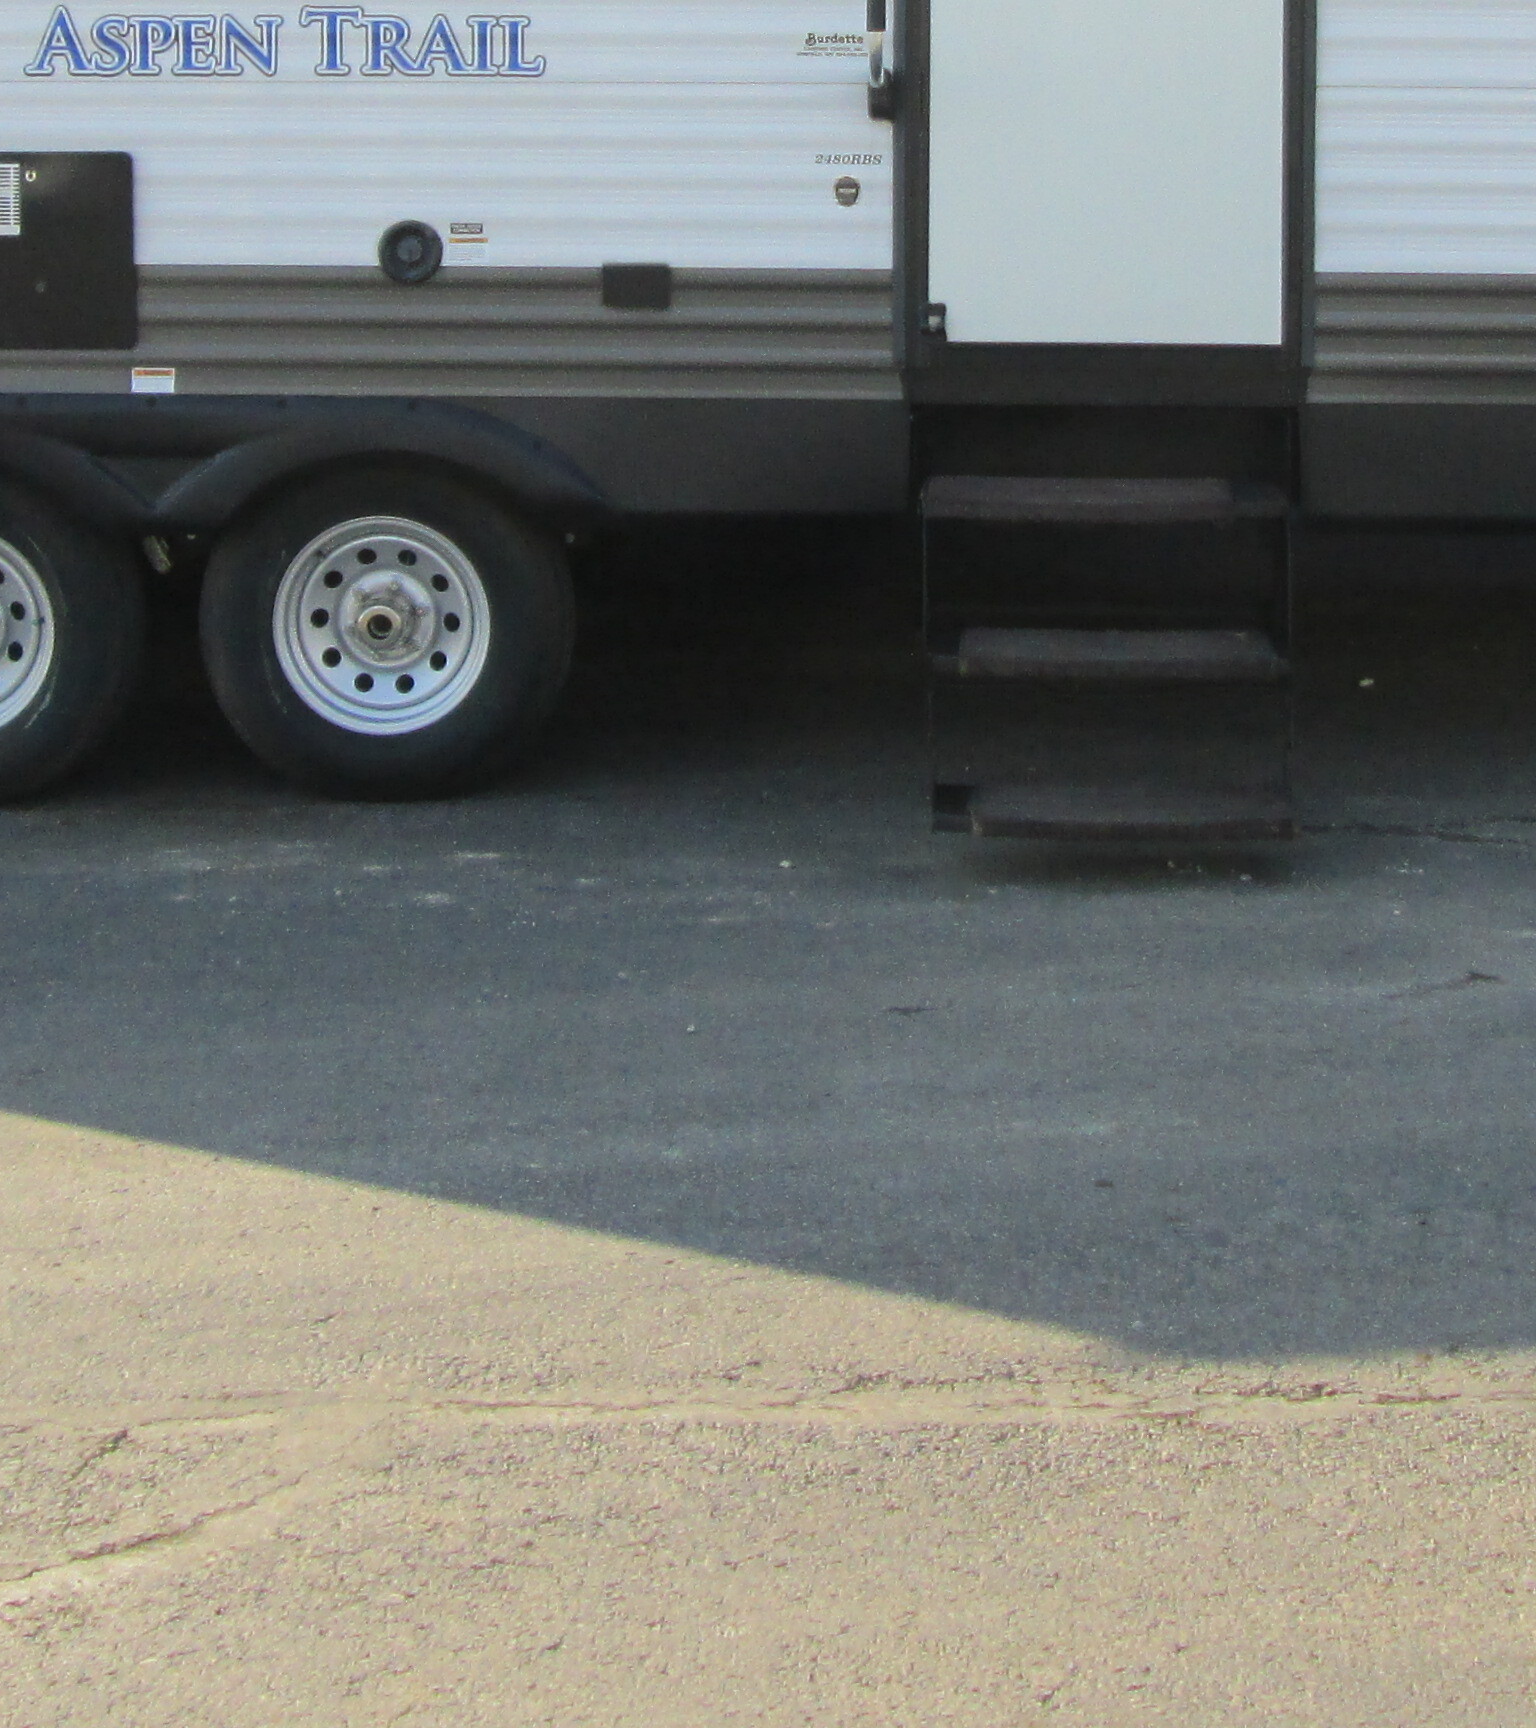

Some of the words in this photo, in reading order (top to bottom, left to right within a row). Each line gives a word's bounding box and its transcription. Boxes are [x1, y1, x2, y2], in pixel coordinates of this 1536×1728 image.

[23, 4, 284, 78] ASPEN
[299, 4, 547, 78] TRAIL
[805, 32, 864, 46] Burdette
[814, 153, 883, 165] 2480RBS
